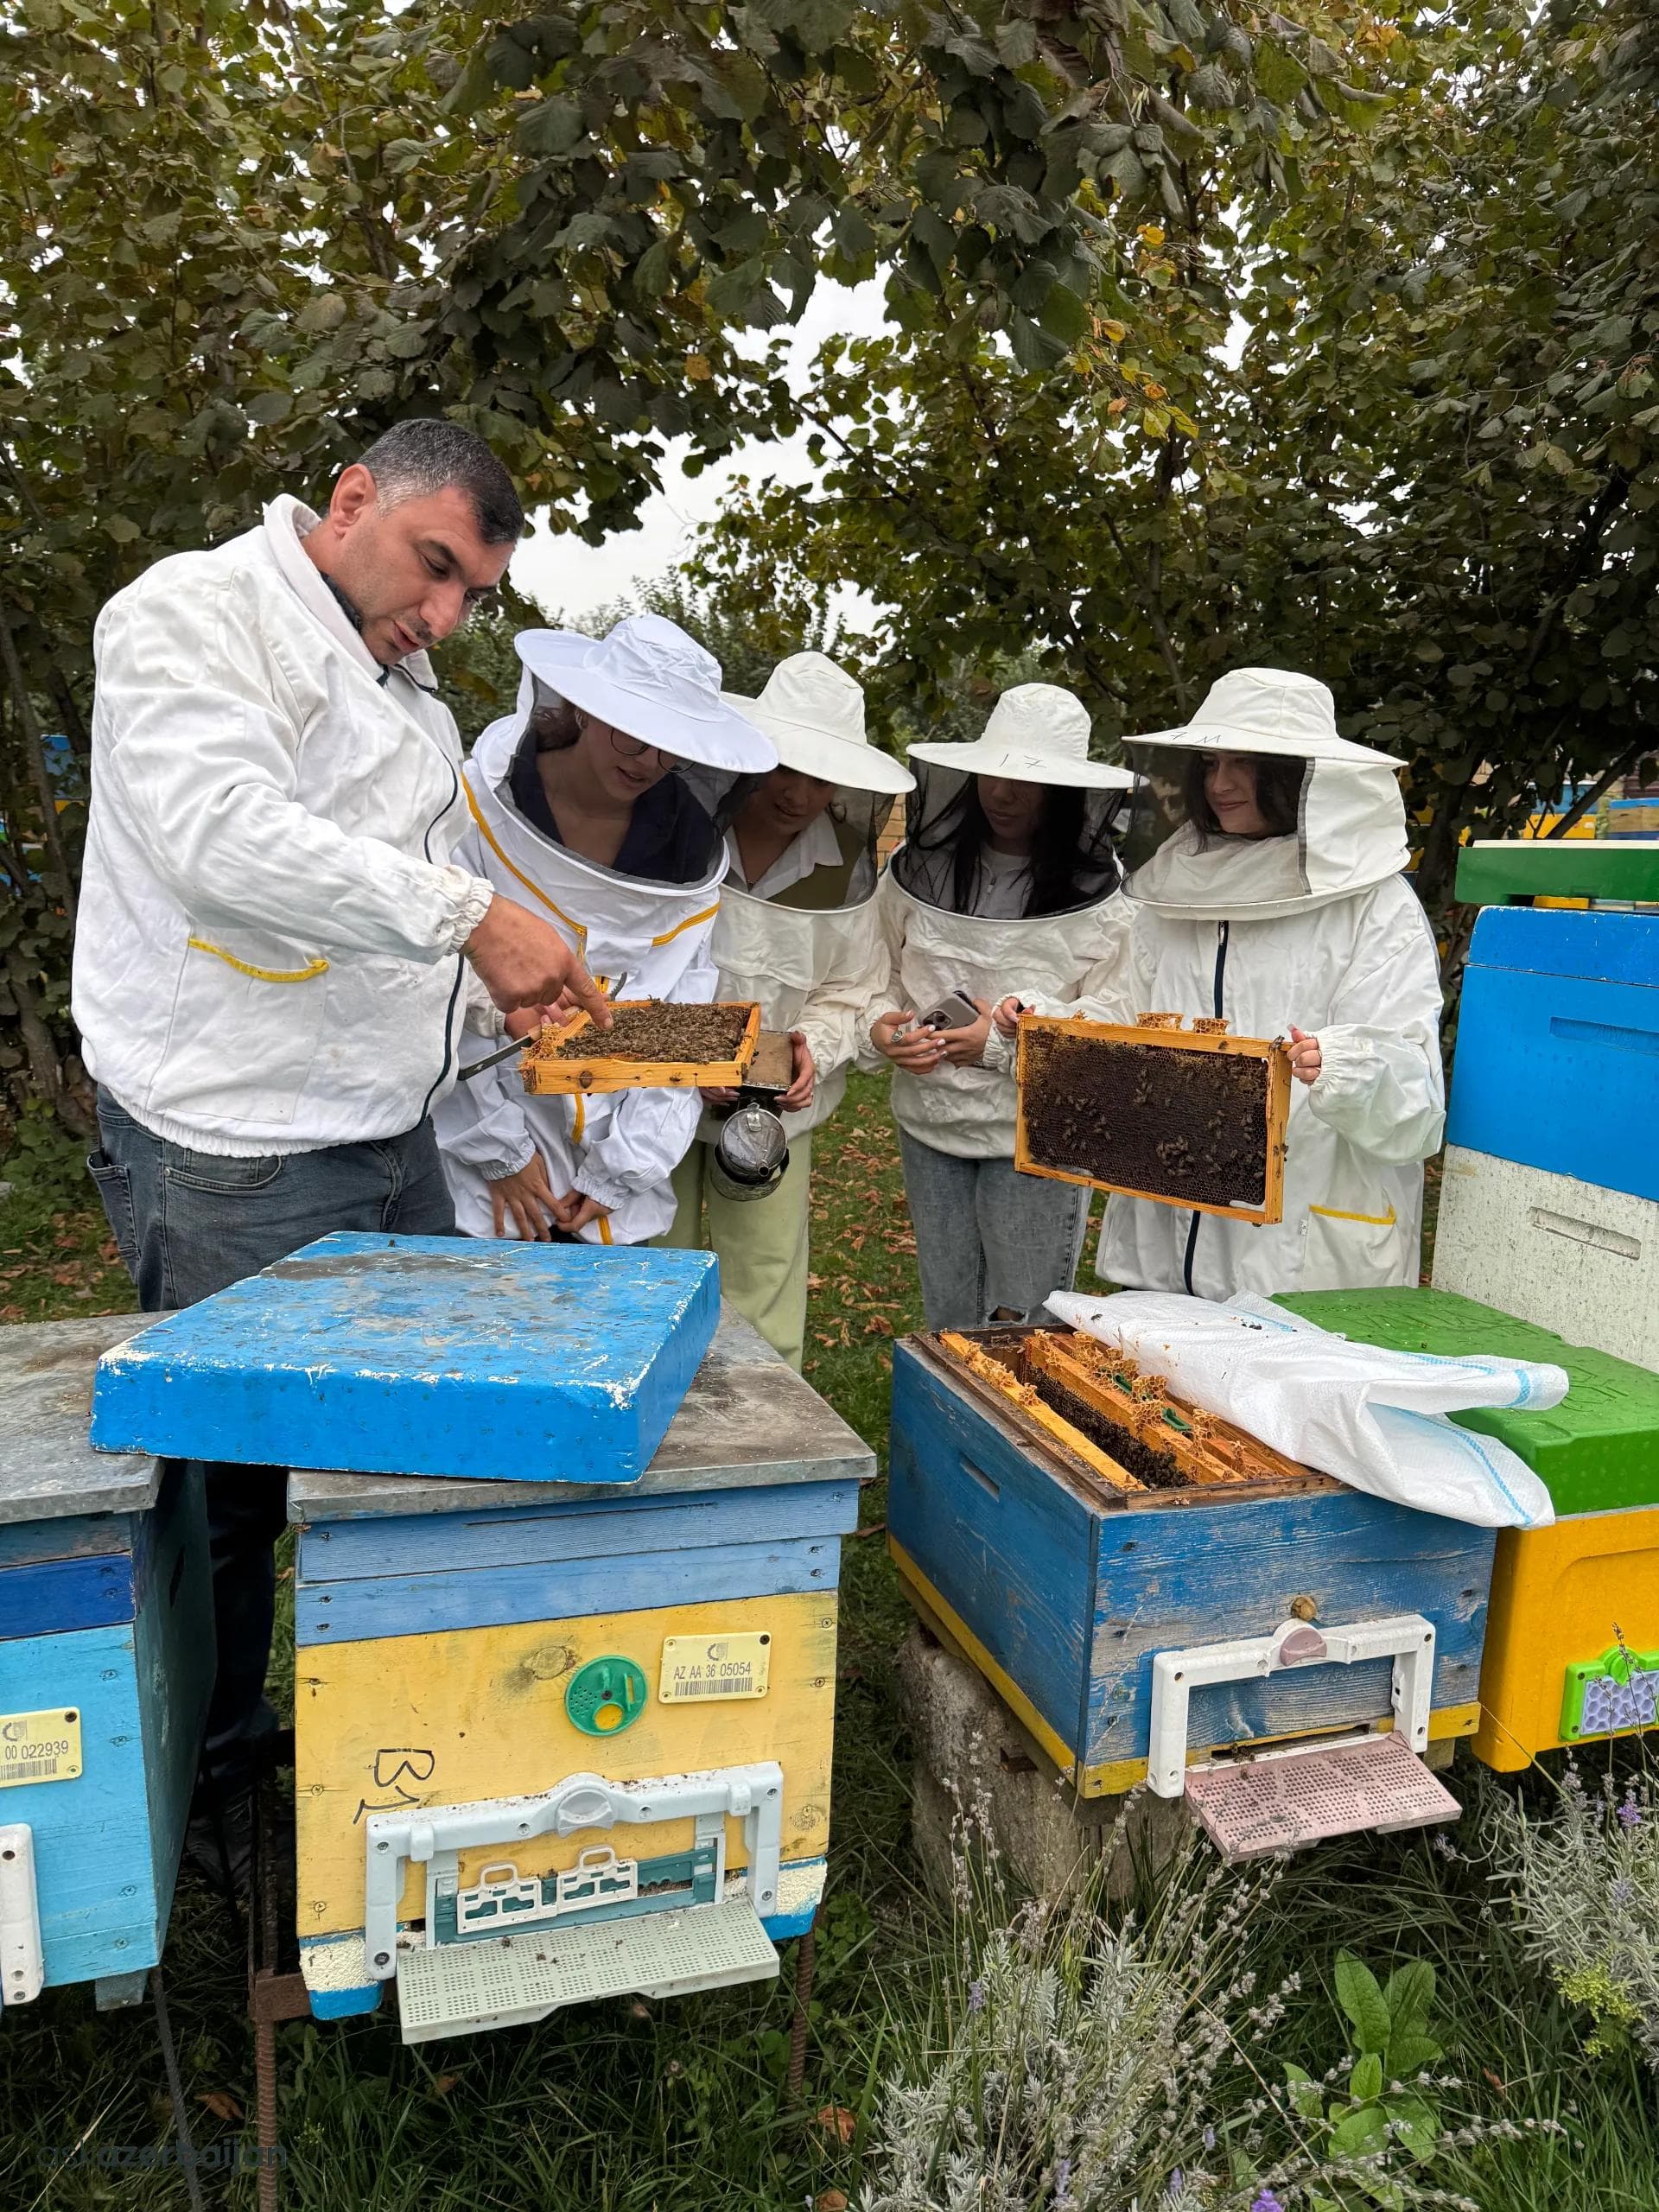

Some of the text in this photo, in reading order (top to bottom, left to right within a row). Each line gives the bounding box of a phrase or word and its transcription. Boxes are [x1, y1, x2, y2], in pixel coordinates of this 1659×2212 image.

[673, 1666, 686, 1680] AZ
[690, 1665, 702, 1679] AA
[705, 1664, 715, 1678] 36
[720, 1661, 752, 1676] 05054
[4, 1739, 69, 1760] 00 022939
